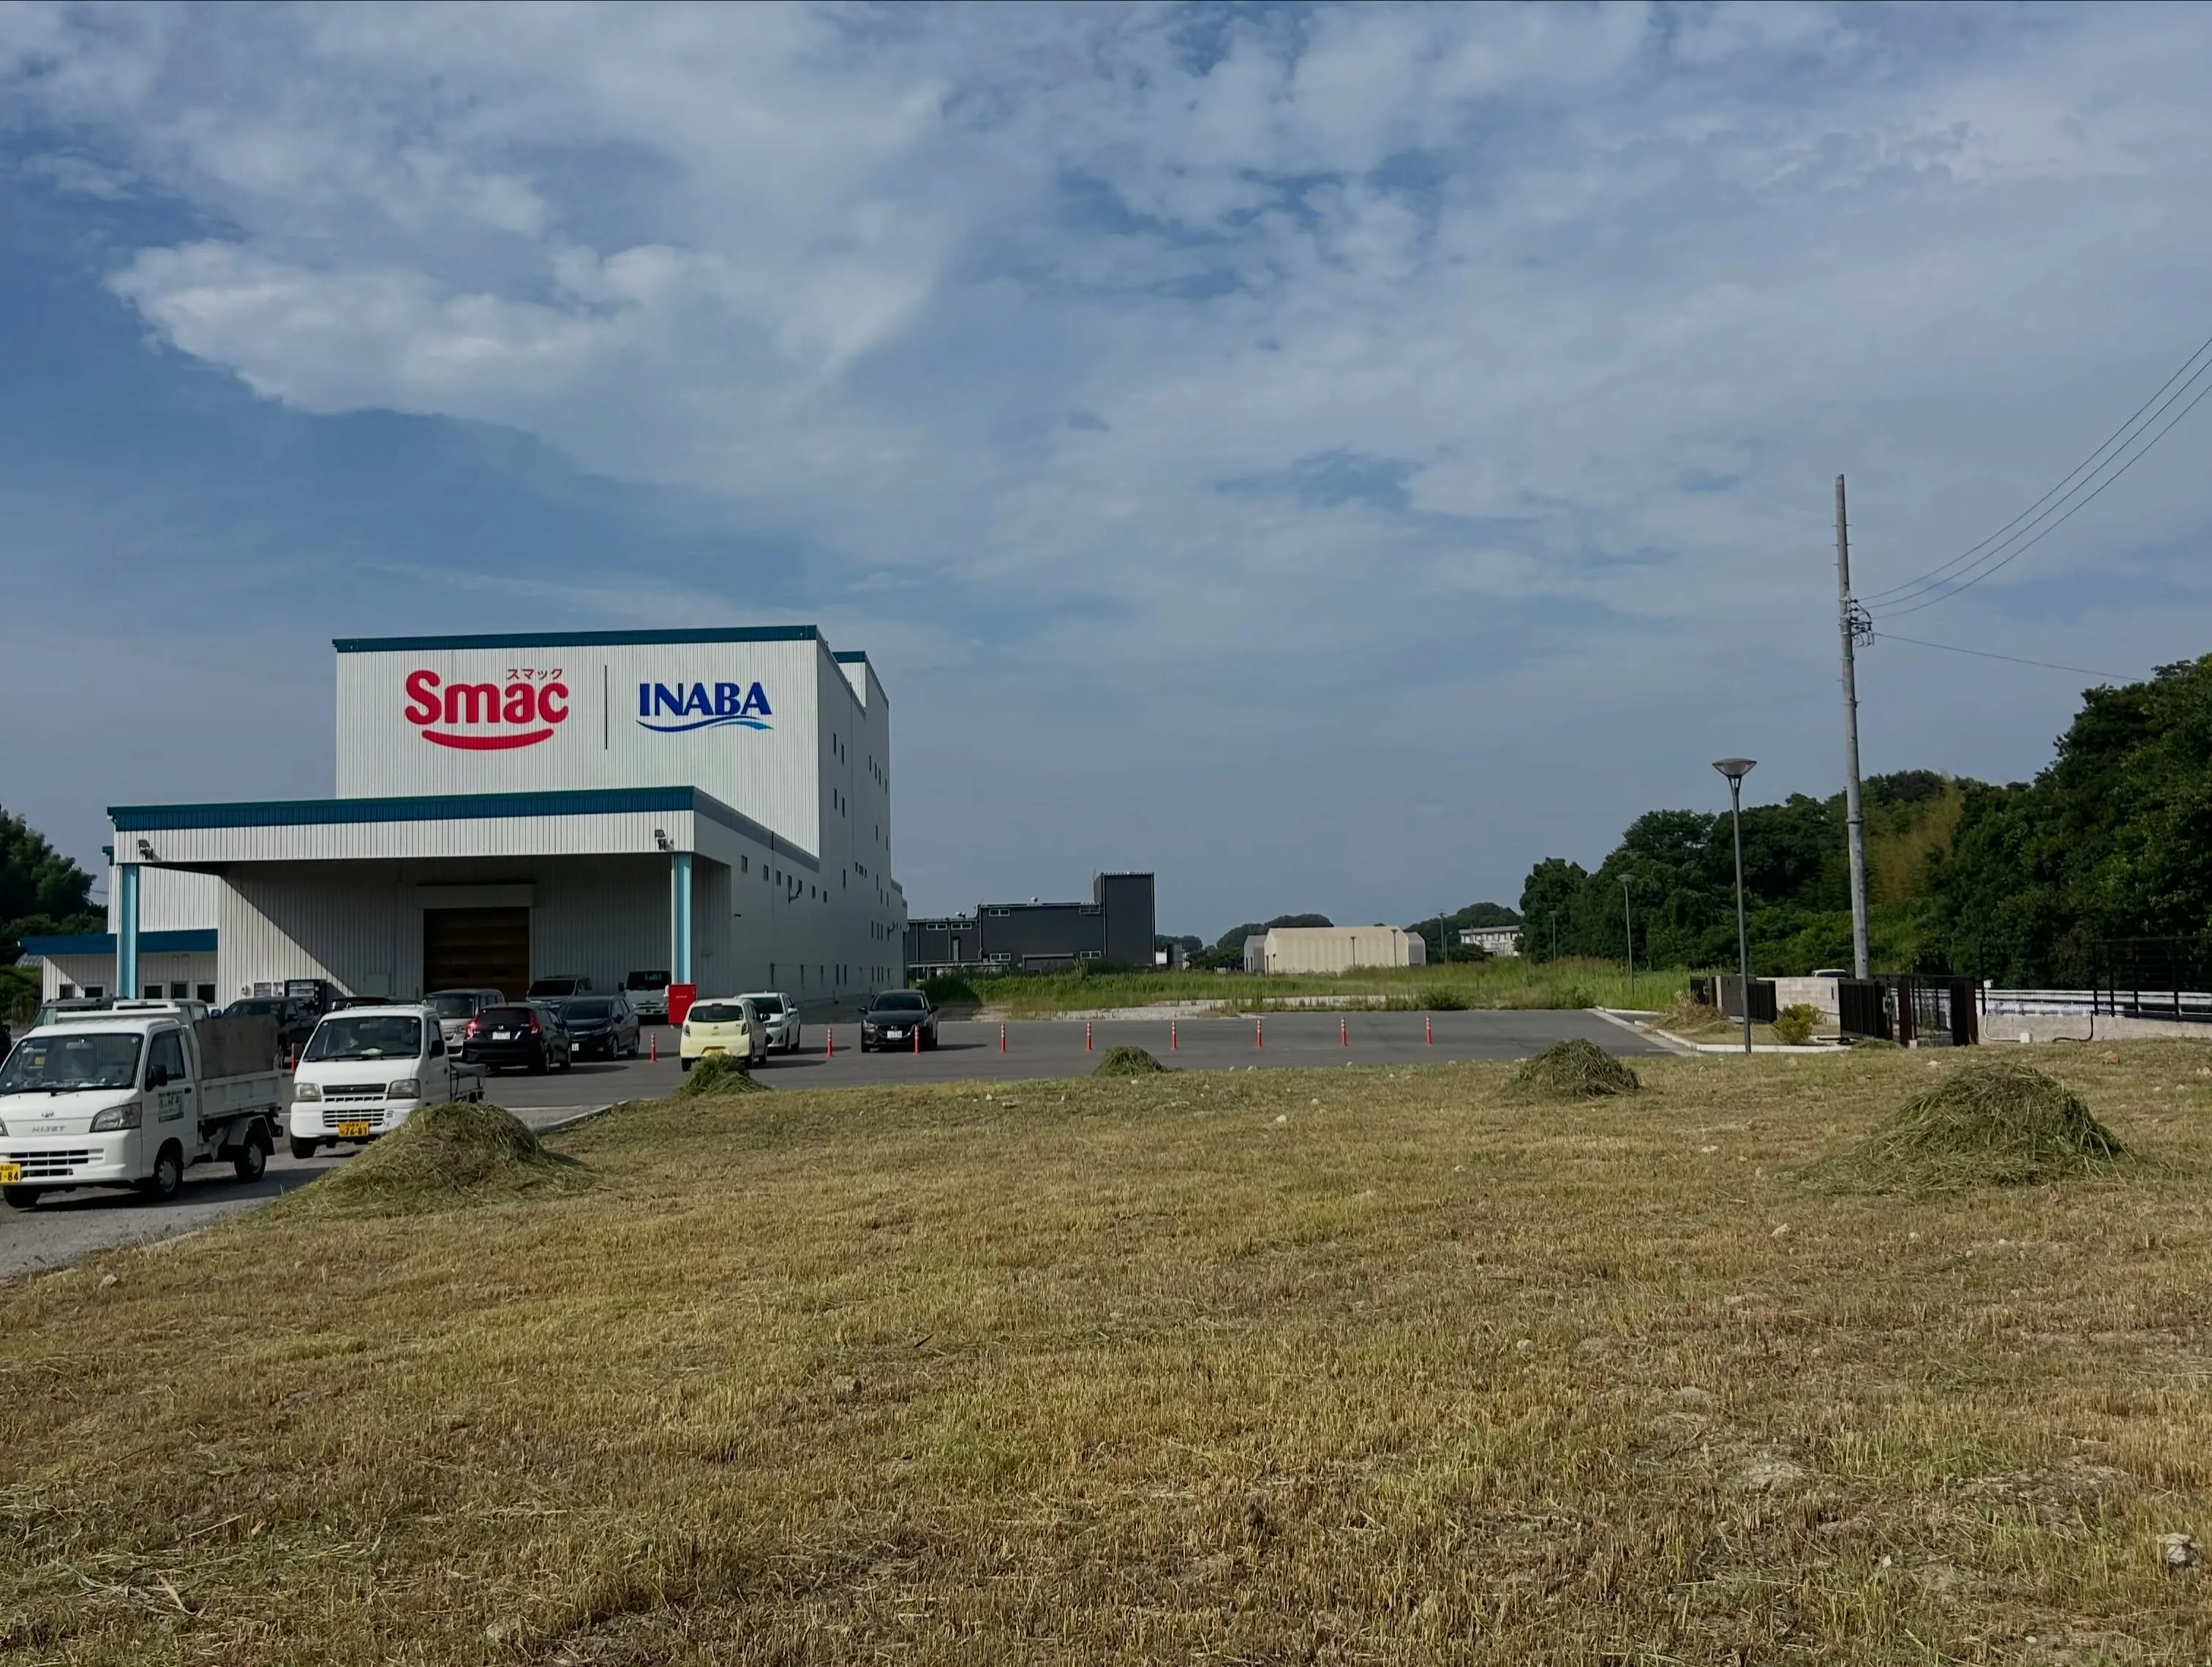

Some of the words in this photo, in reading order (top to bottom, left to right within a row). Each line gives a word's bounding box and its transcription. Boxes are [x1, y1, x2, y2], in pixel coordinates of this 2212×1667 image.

[507, 668, 563, 680] スマック
[405, 669, 569, 725] Smac
[639, 682, 772, 716] INABA
